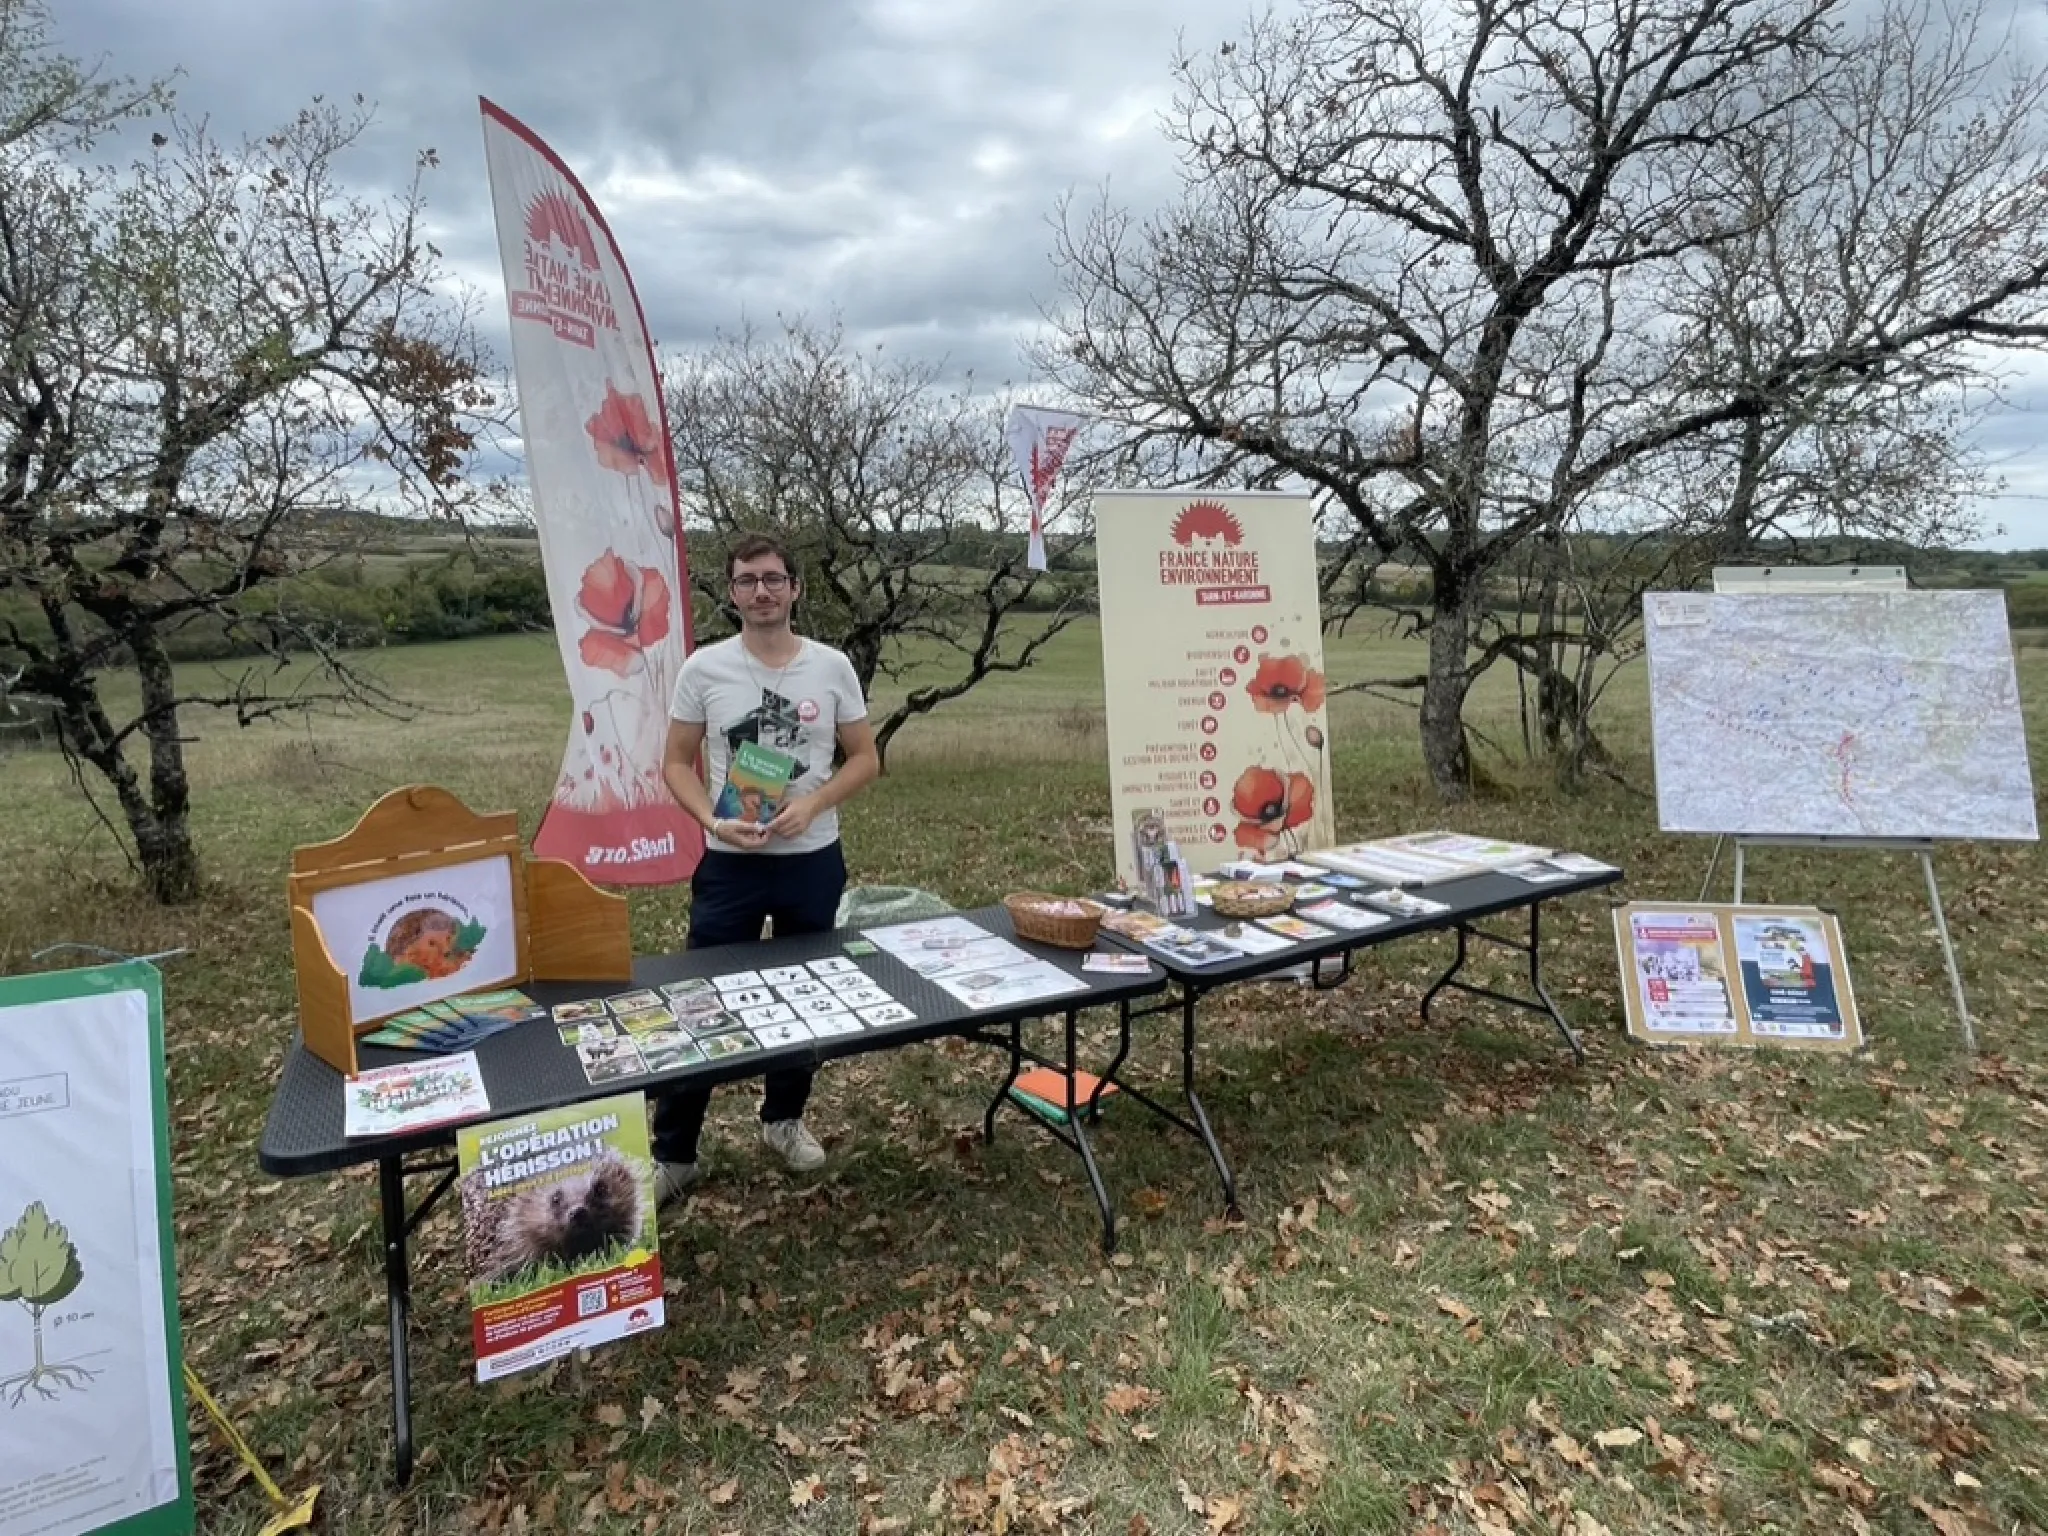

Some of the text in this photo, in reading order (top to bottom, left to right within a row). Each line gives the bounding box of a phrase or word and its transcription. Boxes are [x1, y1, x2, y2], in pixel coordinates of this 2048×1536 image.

[1159, 550, 1259, 568] FRANCE NATURE
[1160, 567, 1259, 586] ENVIRONNEMENT
[481, 1112, 620, 1167] L'OPÉRATION
[484, 1139, 592, 1188] HÉRISSON
